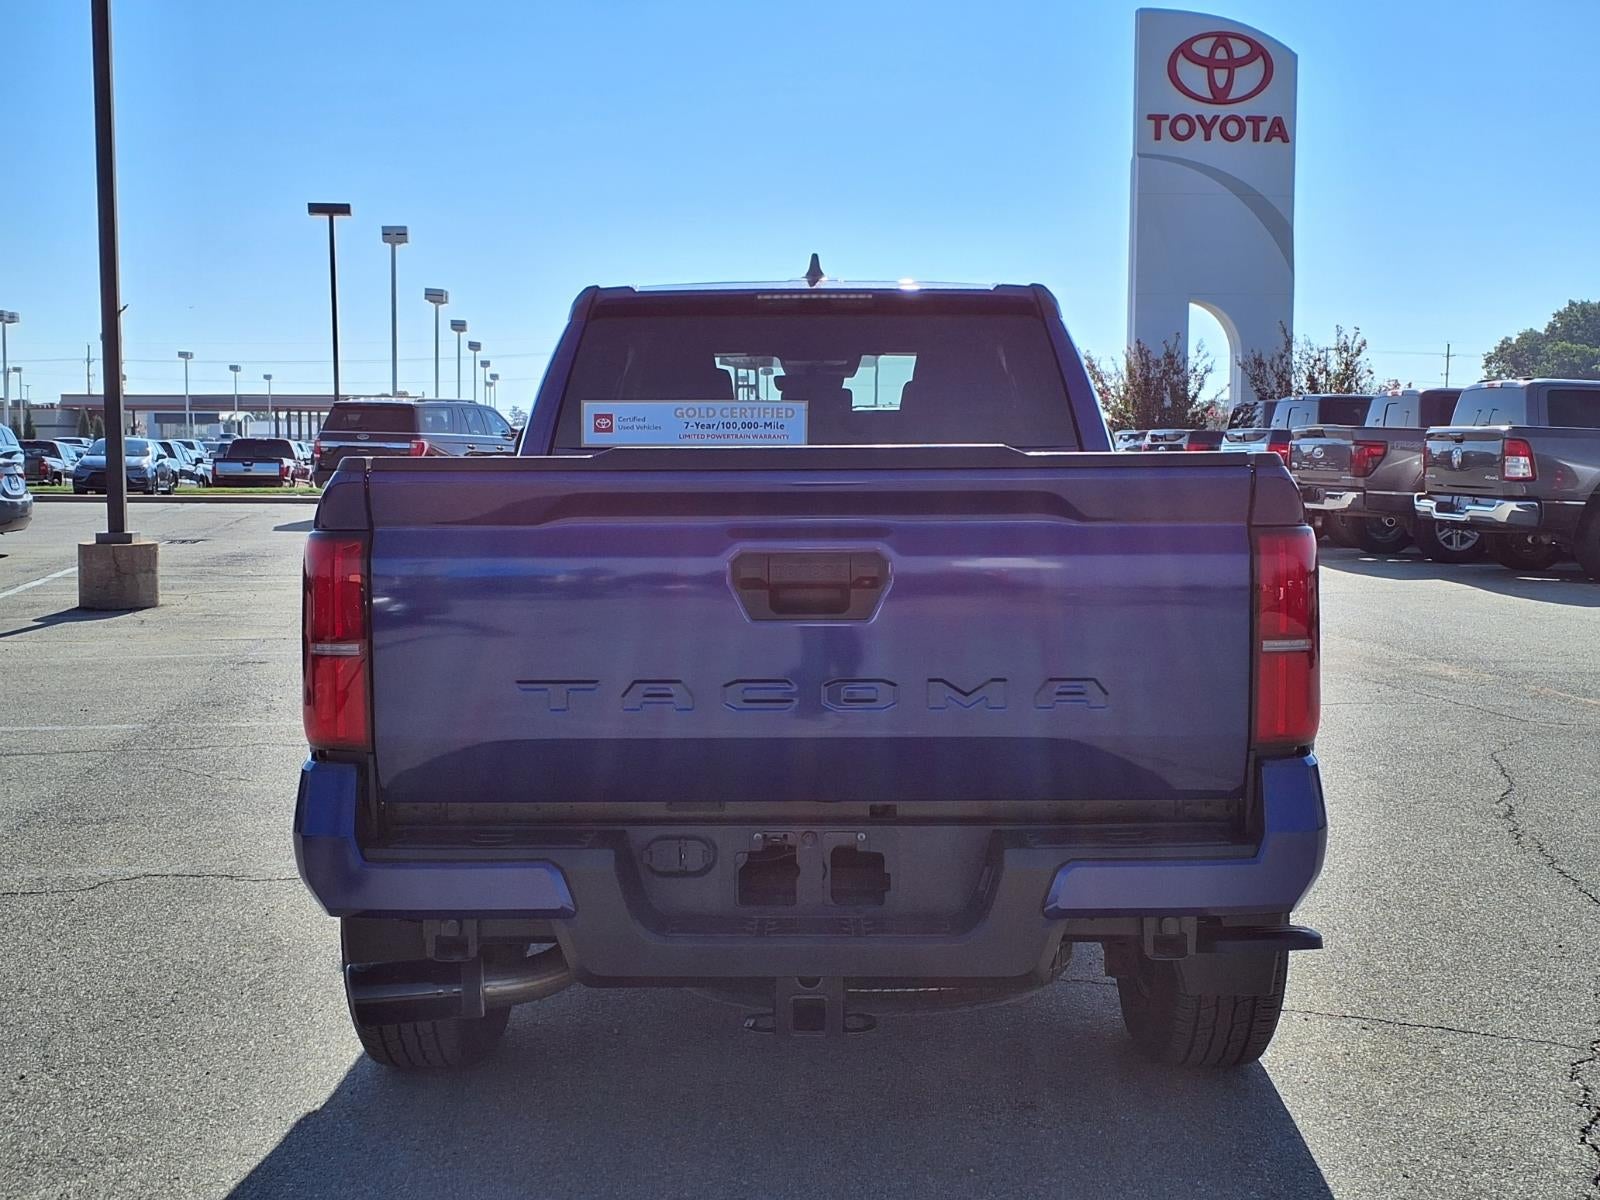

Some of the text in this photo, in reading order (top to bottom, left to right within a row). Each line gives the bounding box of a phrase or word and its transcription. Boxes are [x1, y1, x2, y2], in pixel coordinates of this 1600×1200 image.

[1147, 113, 1290, 143] TOYOTA
[674, 407, 796, 419] GOLD CERTIFIED
[684, 421, 785, 431] 7-Year/100,000-Mile
[515, 678, 1109, 714] TACOMA
